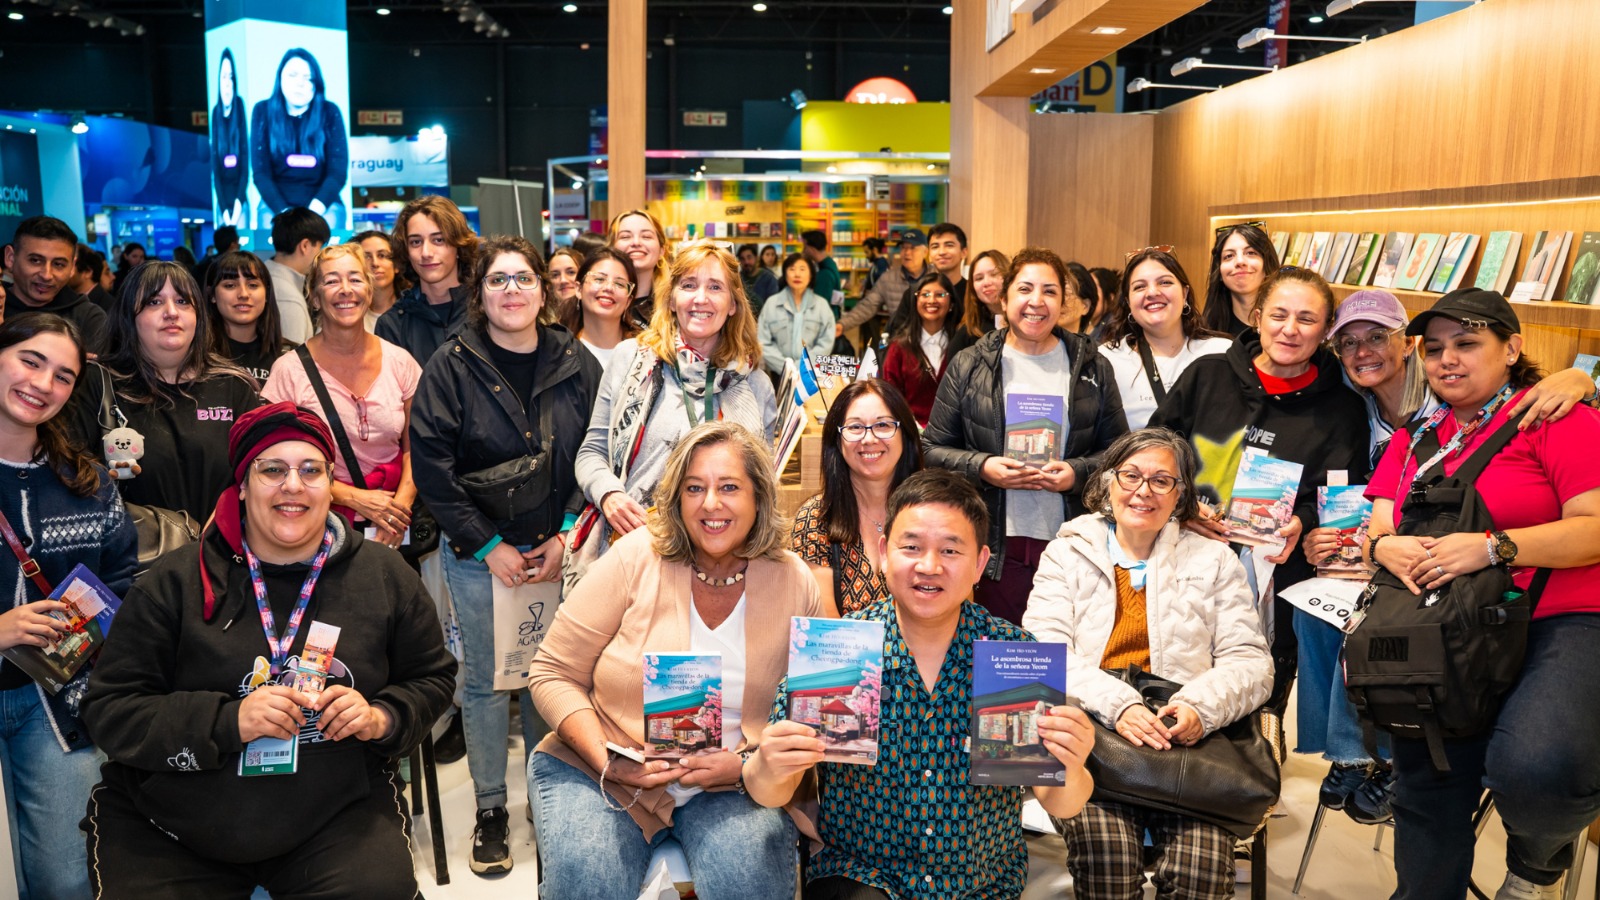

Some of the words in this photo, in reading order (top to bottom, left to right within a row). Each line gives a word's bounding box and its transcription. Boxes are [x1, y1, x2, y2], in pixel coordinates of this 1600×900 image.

[196, 408, 234, 422] BUZ
[1240, 425, 1276, 446] HOPE
[818, 641, 852, 650] maravillas
